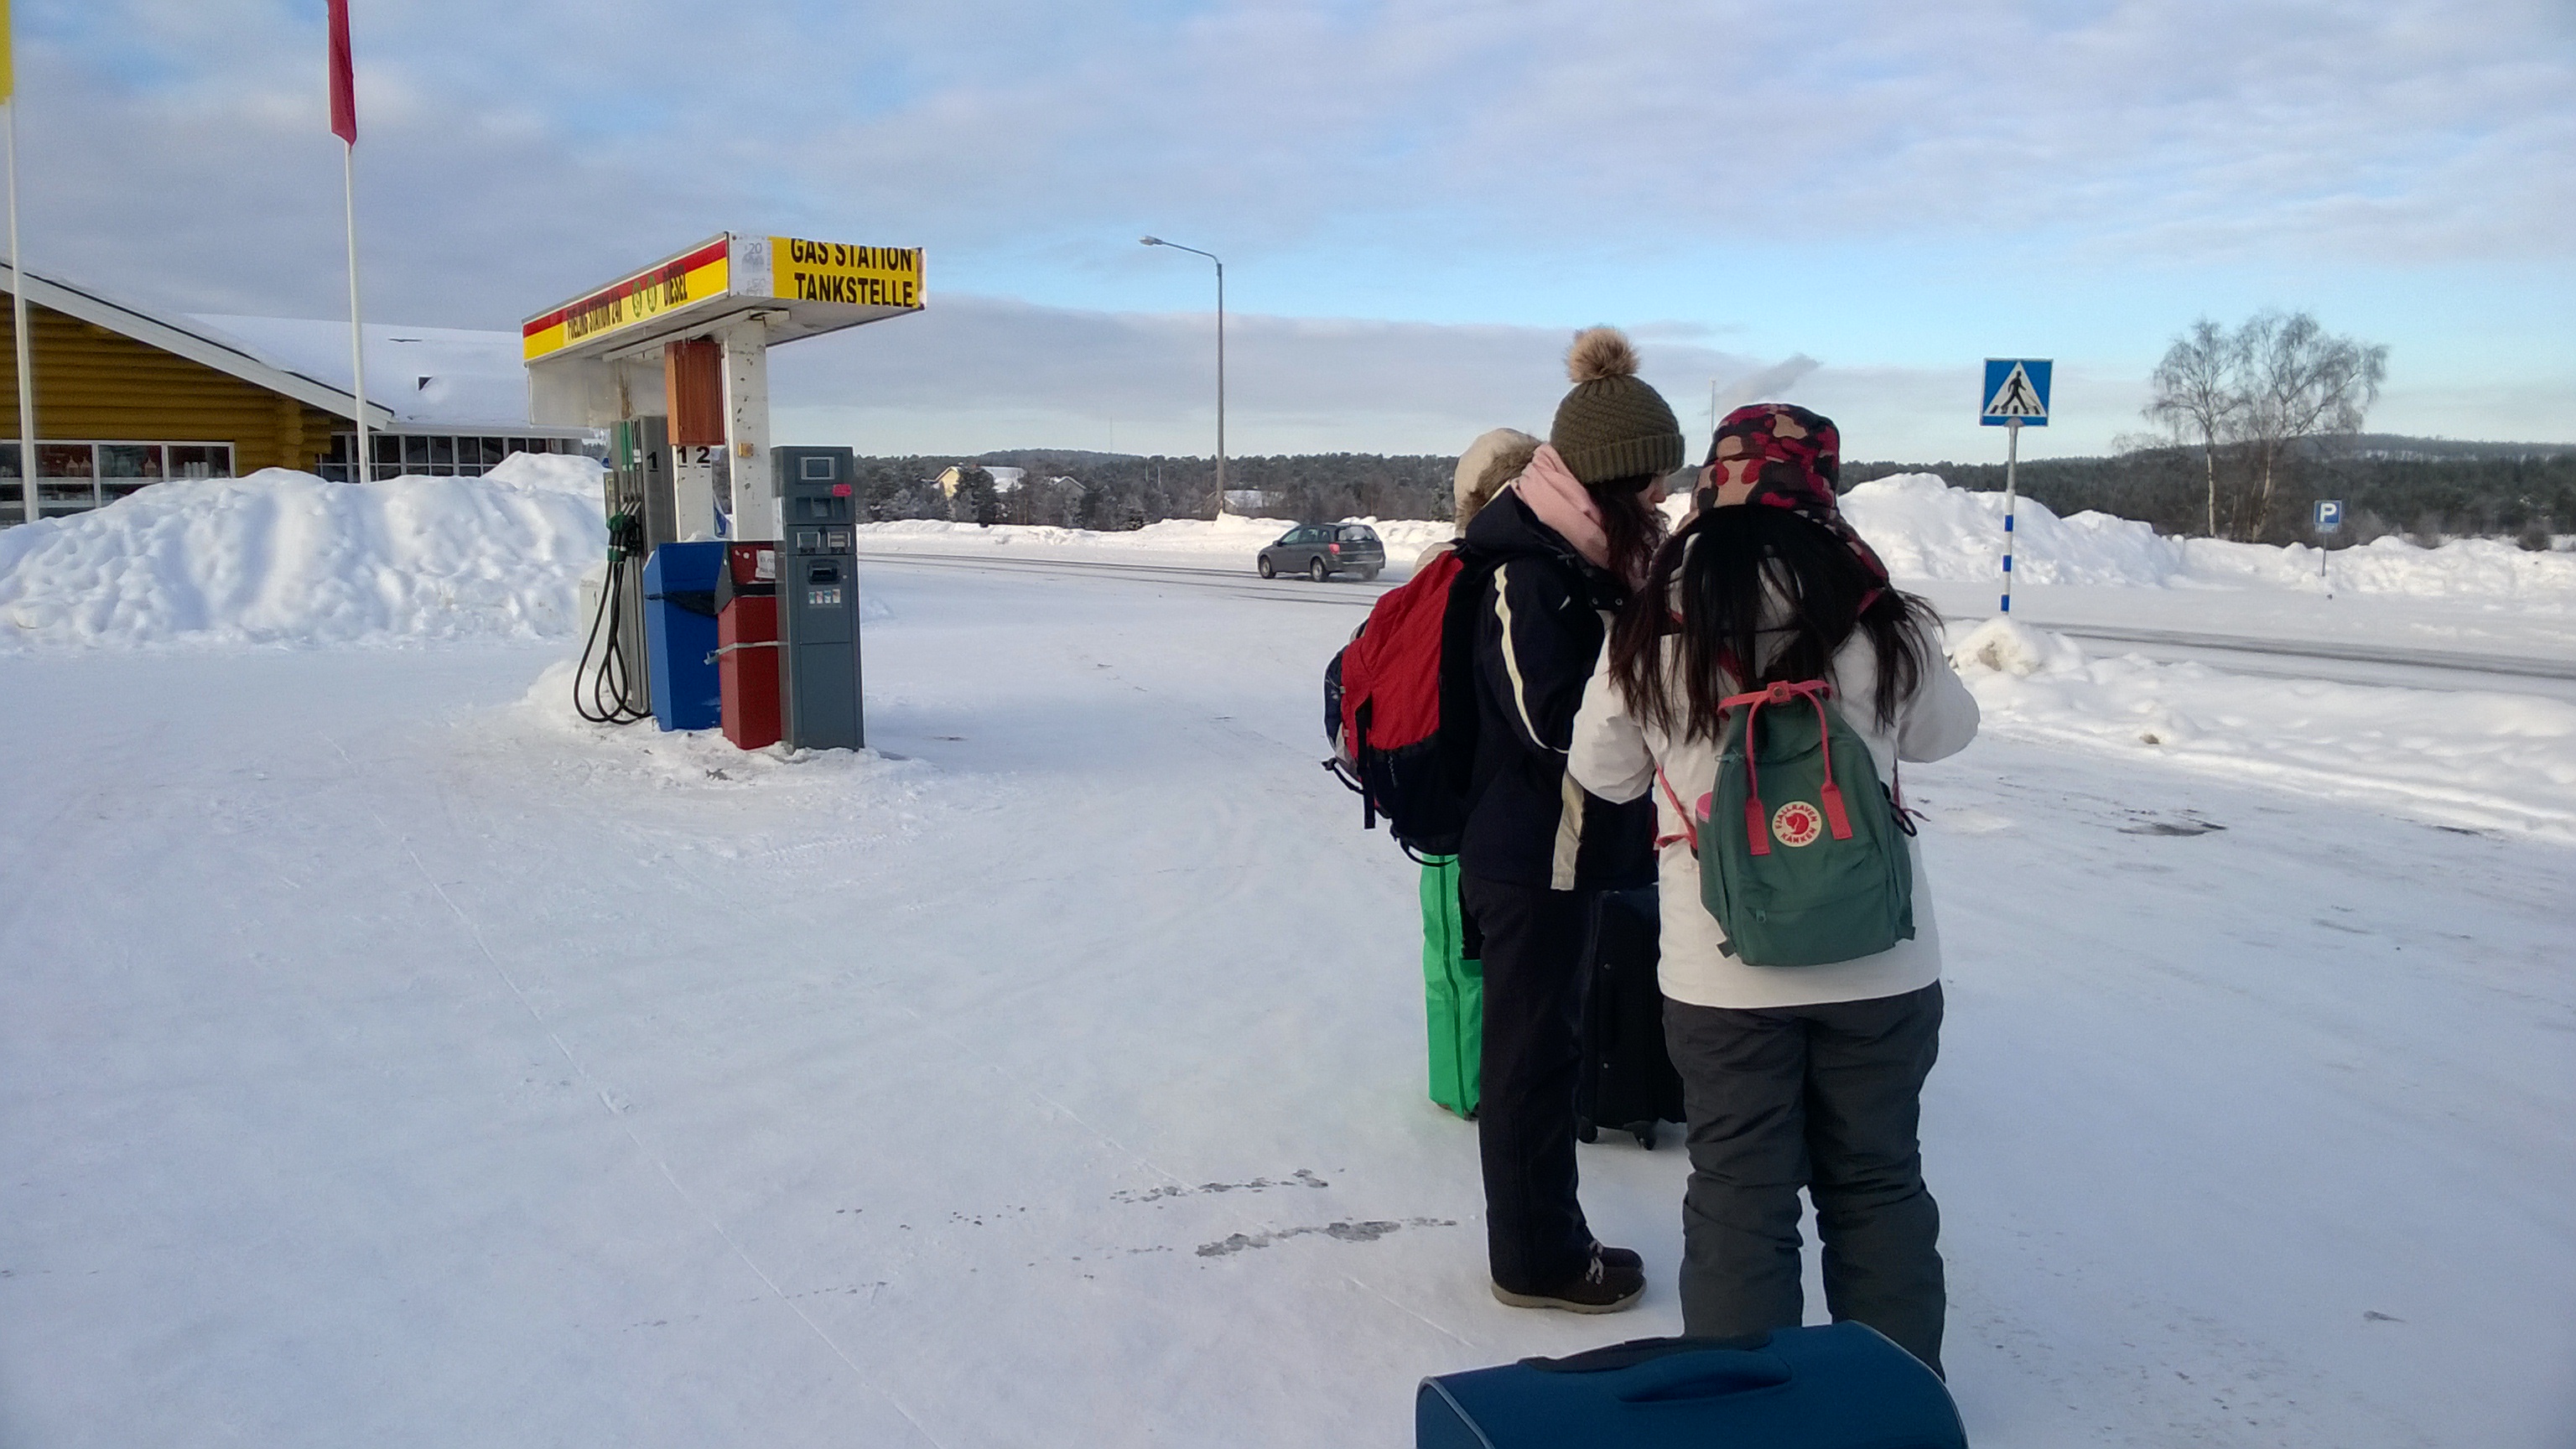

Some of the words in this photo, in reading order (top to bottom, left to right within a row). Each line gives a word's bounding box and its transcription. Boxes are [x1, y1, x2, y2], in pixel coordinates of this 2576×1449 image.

[791, 238, 829, 266] GAS
[834, 243, 913, 272] STATION
[662, 263, 688, 307] DIESEL
[794, 273, 914, 308] TANKSTELLE
[647, 451, 658, 470] 1
[677, 446, 688, 464] 1
[696, 446, 710, 464] 2
[2320, 503, 2336, 522] P
